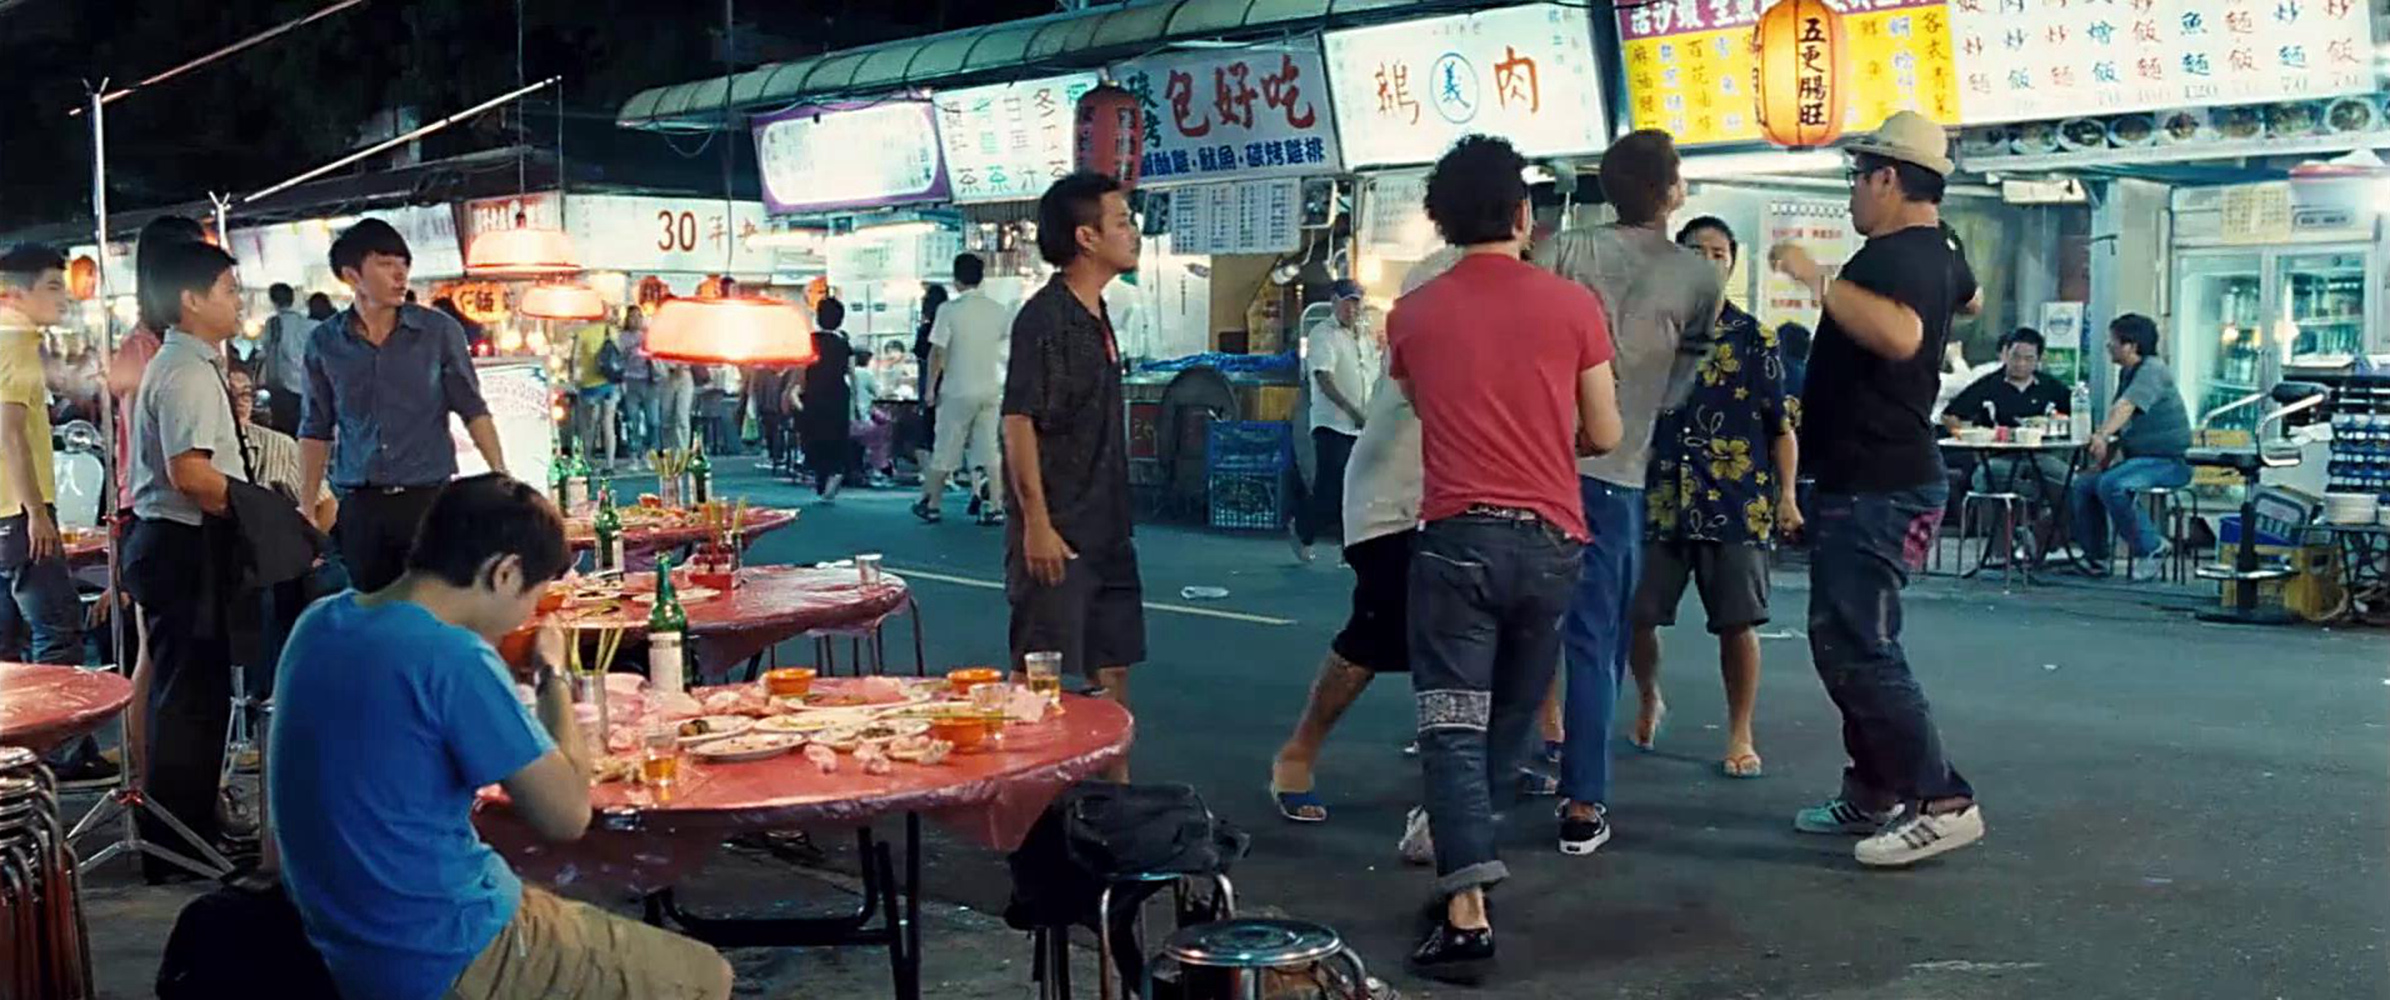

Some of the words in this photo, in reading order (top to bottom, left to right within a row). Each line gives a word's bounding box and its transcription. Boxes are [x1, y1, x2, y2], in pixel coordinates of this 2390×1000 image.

[1799, 18, 1827, 126] 五更腸旺
[656, 209, 697, 252] 30
